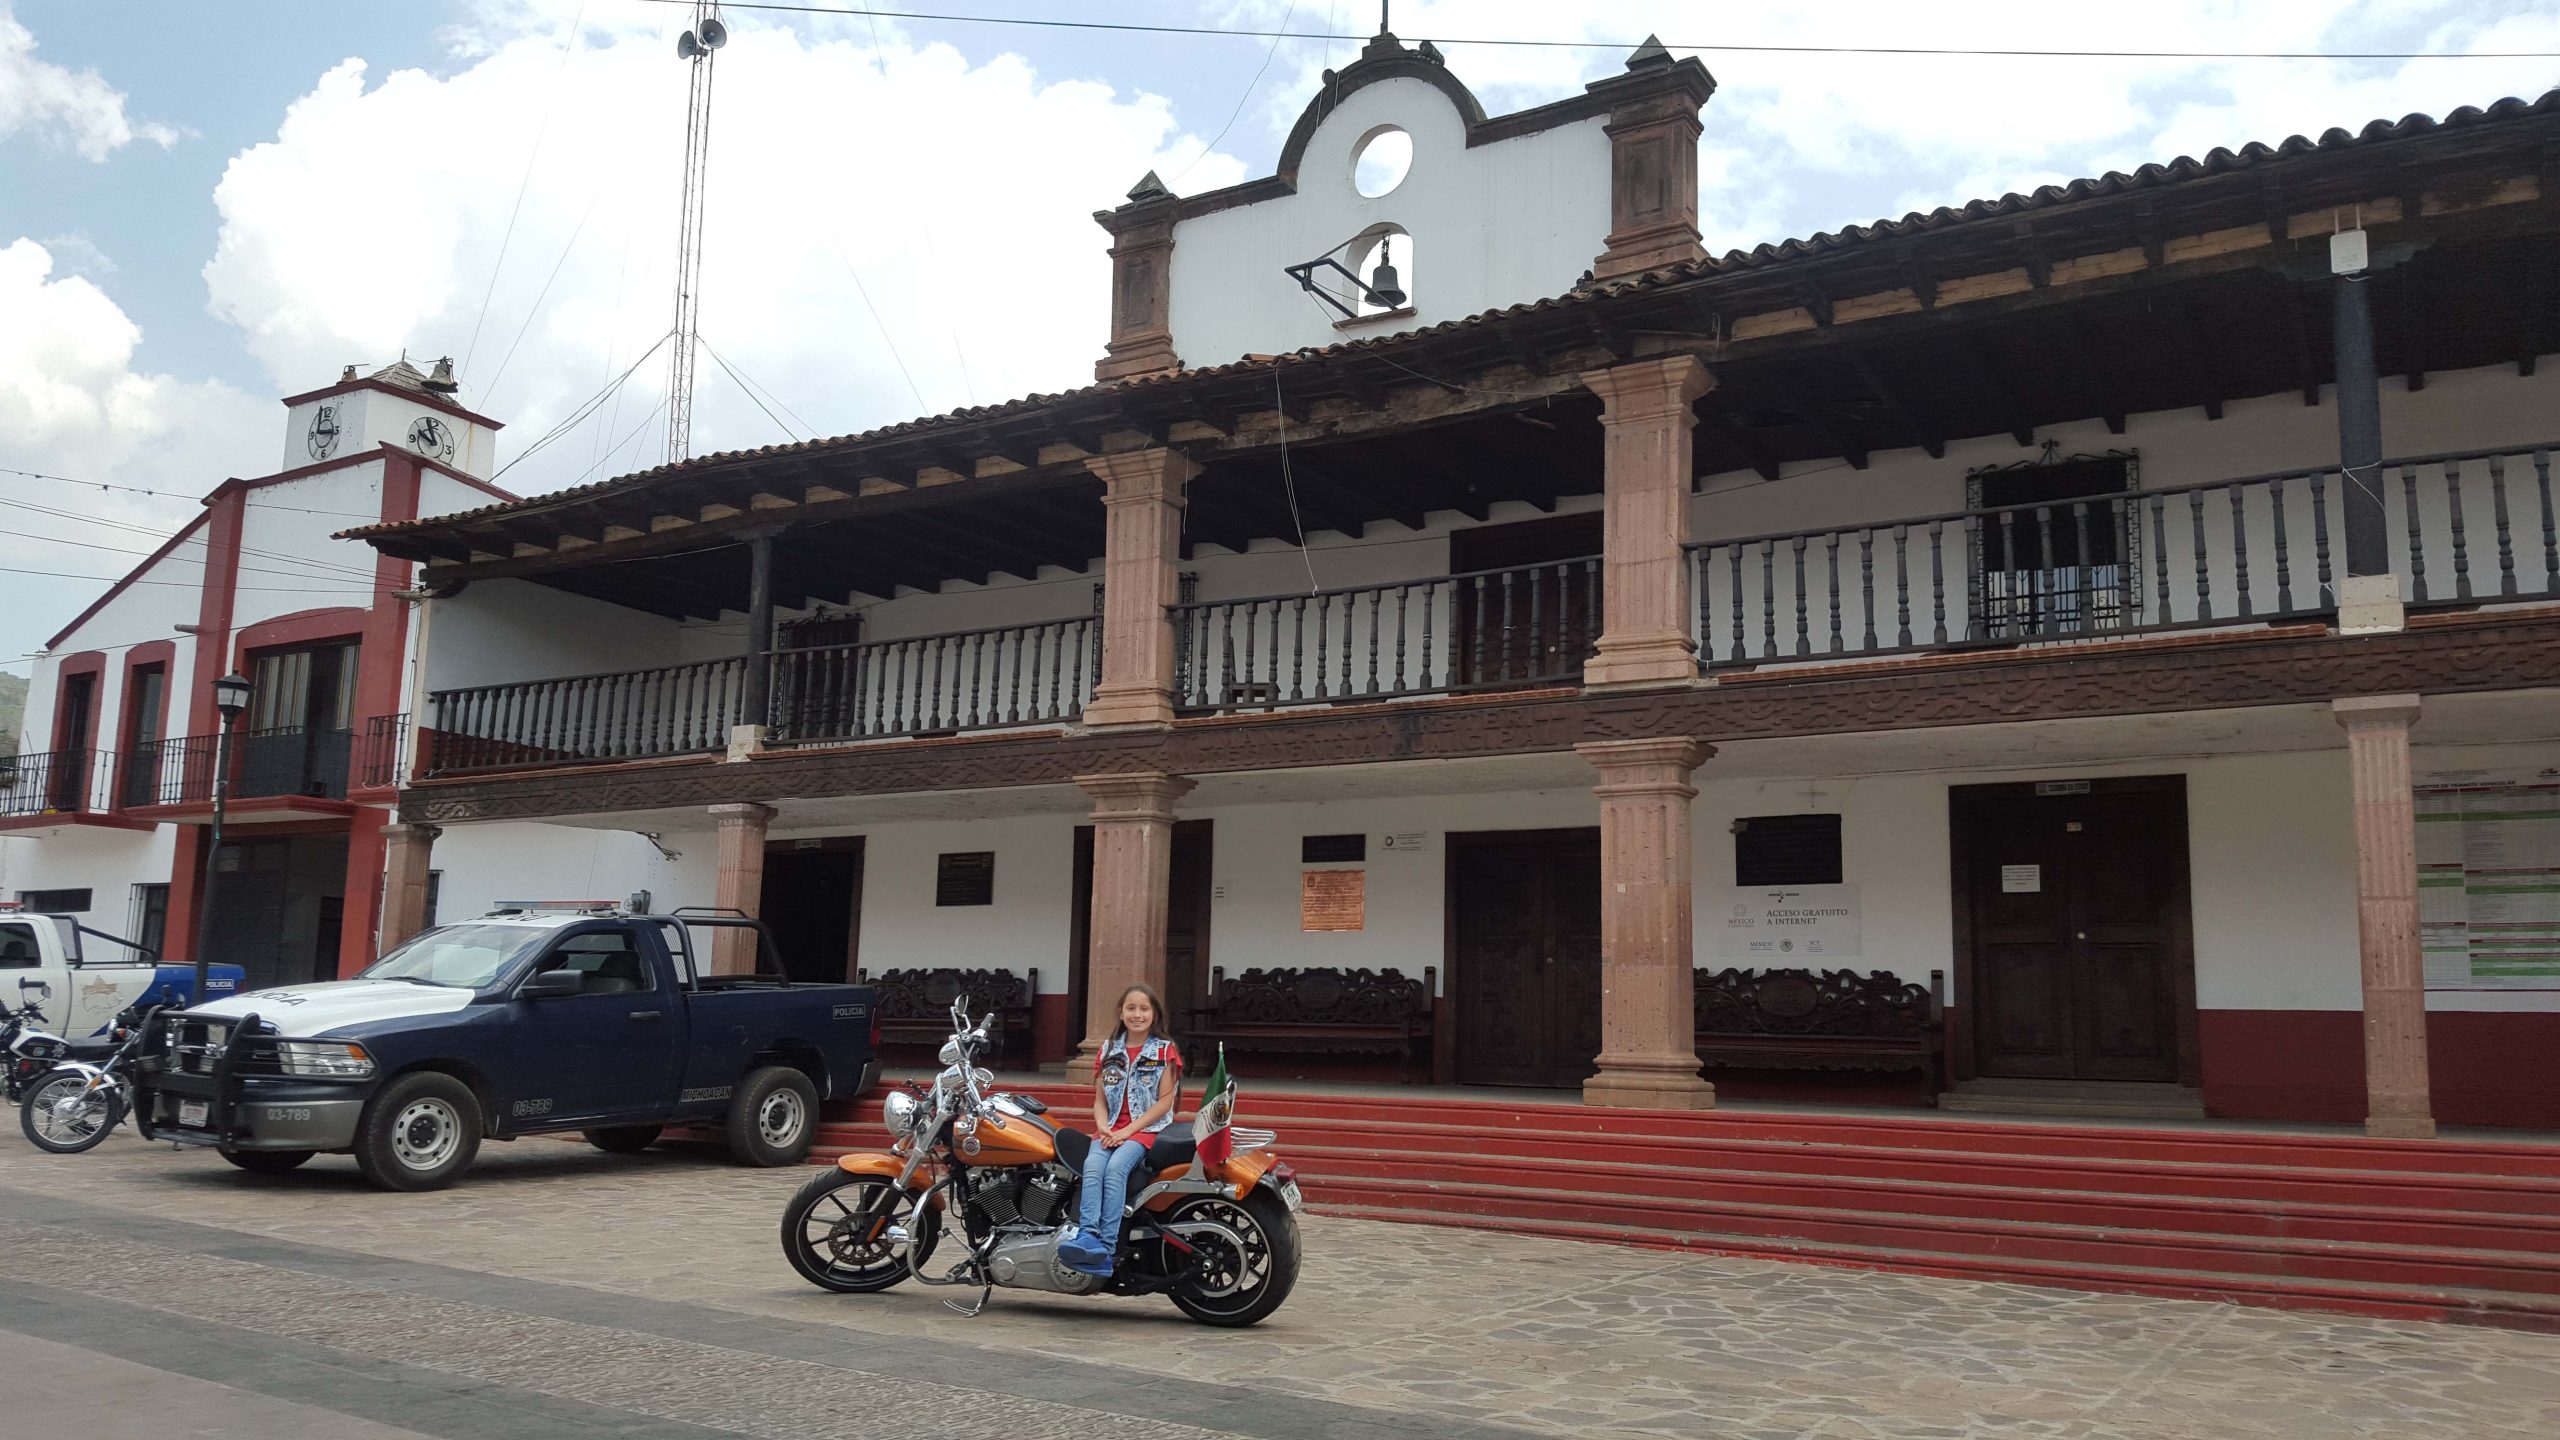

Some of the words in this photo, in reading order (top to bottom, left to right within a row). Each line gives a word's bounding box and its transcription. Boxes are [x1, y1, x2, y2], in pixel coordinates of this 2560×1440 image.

[408, 434, 416, 443] 9
[445, 445, 452, 455] 3
[1766, 909, 1800, 918] ACCESO
[1802, 908, 1848, 917] GRATUITO
[1766, 918, 1773, 926] A
[1775, 917, 1818, 925] INTERNET
[834, 1006, 864, 1017] POLICIA
[682, 1086, 732, 1102] MICHOACAN
[512, 1098, 552, 1116] 03-789
[267, 1108, 311, 1121] 03-789
